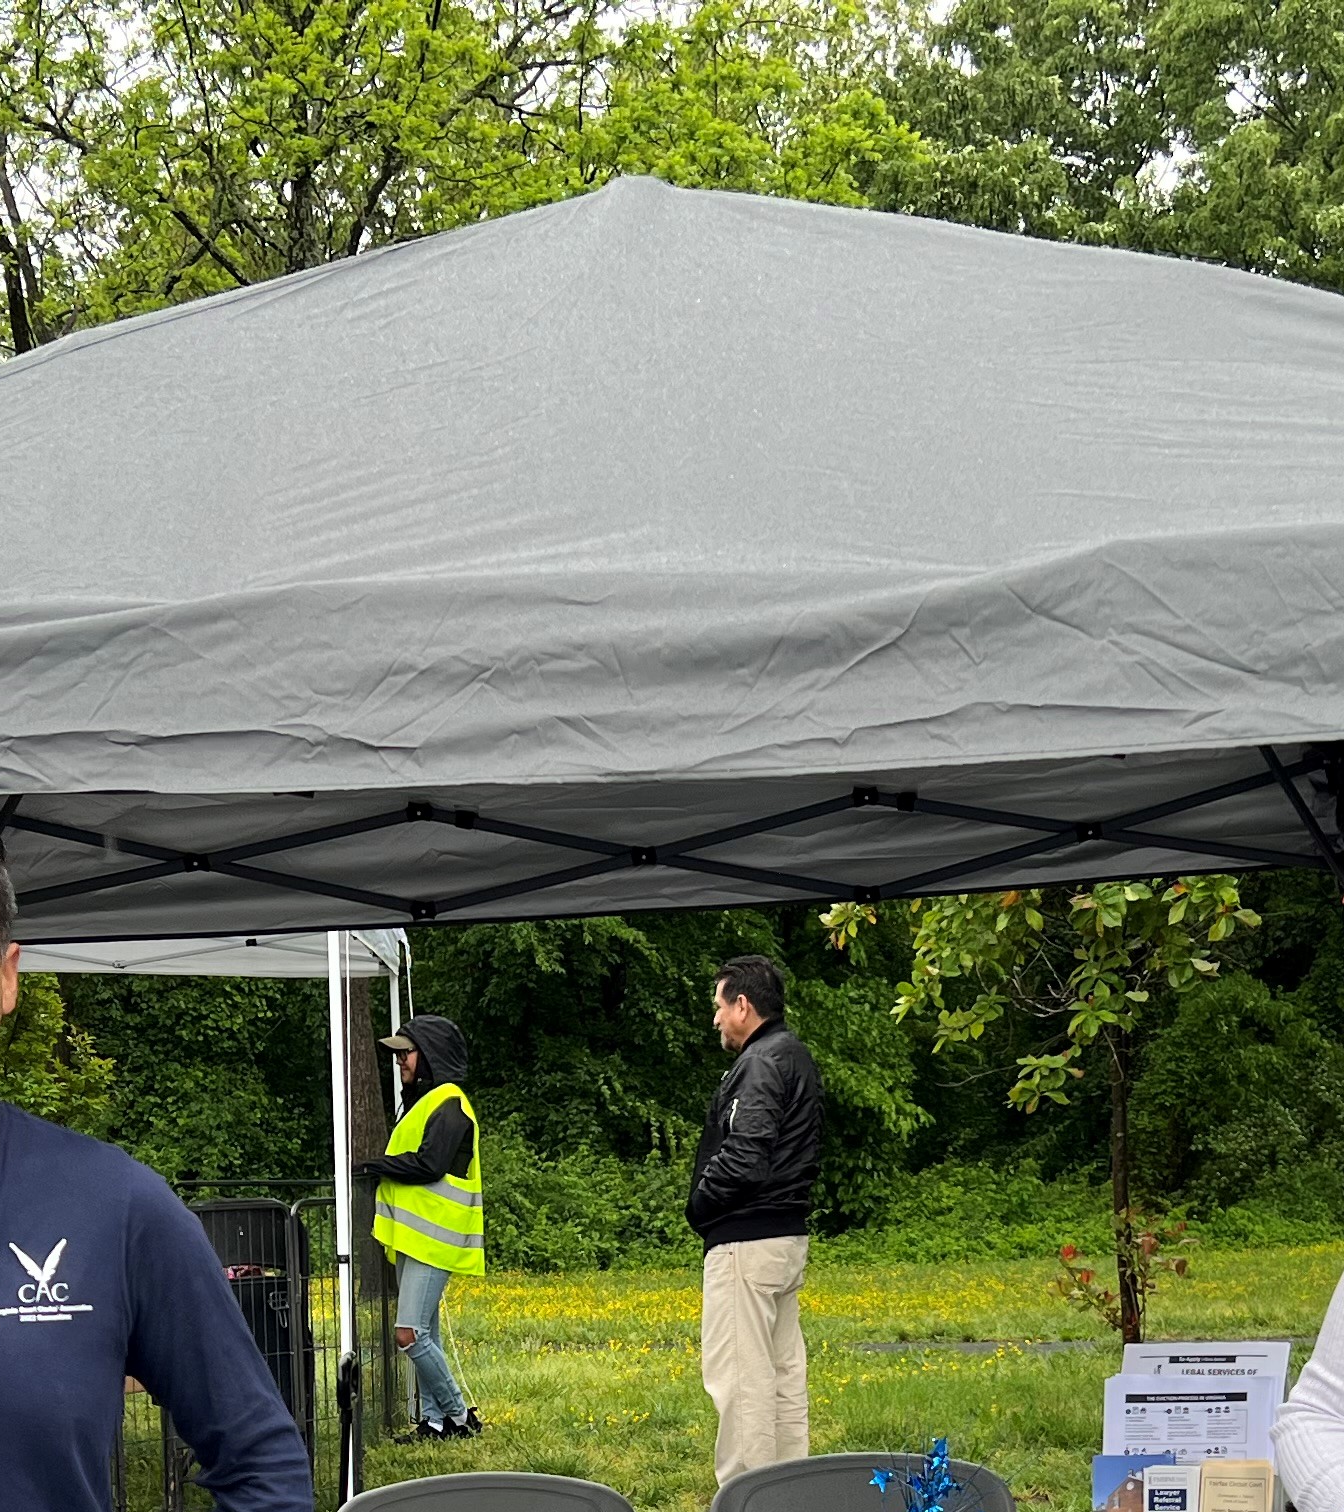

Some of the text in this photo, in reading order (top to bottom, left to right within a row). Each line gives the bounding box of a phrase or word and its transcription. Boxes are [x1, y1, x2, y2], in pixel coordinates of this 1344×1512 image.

[17, 1282, 70, 1304] CAC
[1154, 1489, 1181, 1497] Lawyer
[1153, 1496, 1182, 1504] Referral
[1154, 1503, 1181, 1511] Service
